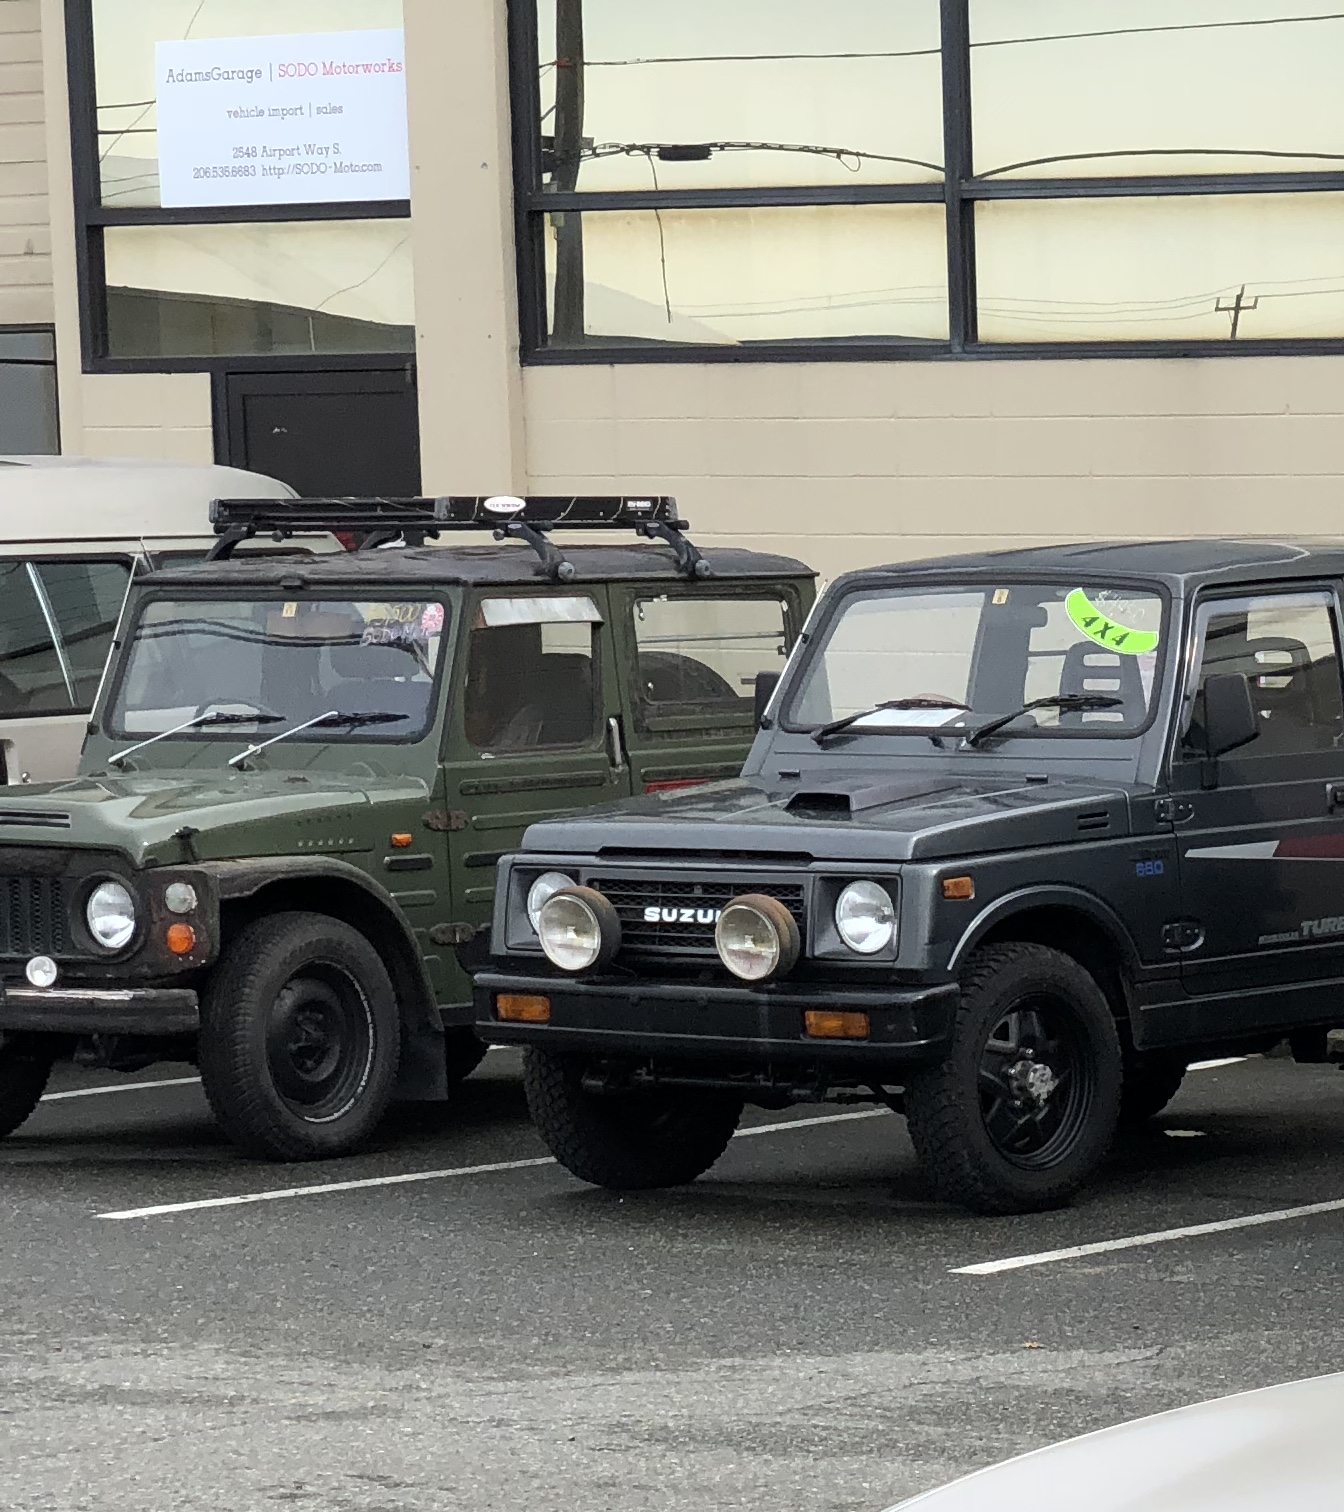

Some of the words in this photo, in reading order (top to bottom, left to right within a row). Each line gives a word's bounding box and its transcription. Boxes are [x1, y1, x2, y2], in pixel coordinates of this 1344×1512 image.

[166, 65, 263, 84] AdamsGarage
[278, 61, 318, 78] SODO
[322, 58, 403, 76] Motorworks
[226, 105, 265, 119] vehicle
[267, 104, 304, 121] import
[316, 103, 344, 116] sales
[260, 144, 301, 160] Airport
[303, 143, 330, 158] Way
[644, 906, 721, 924] SUZU
